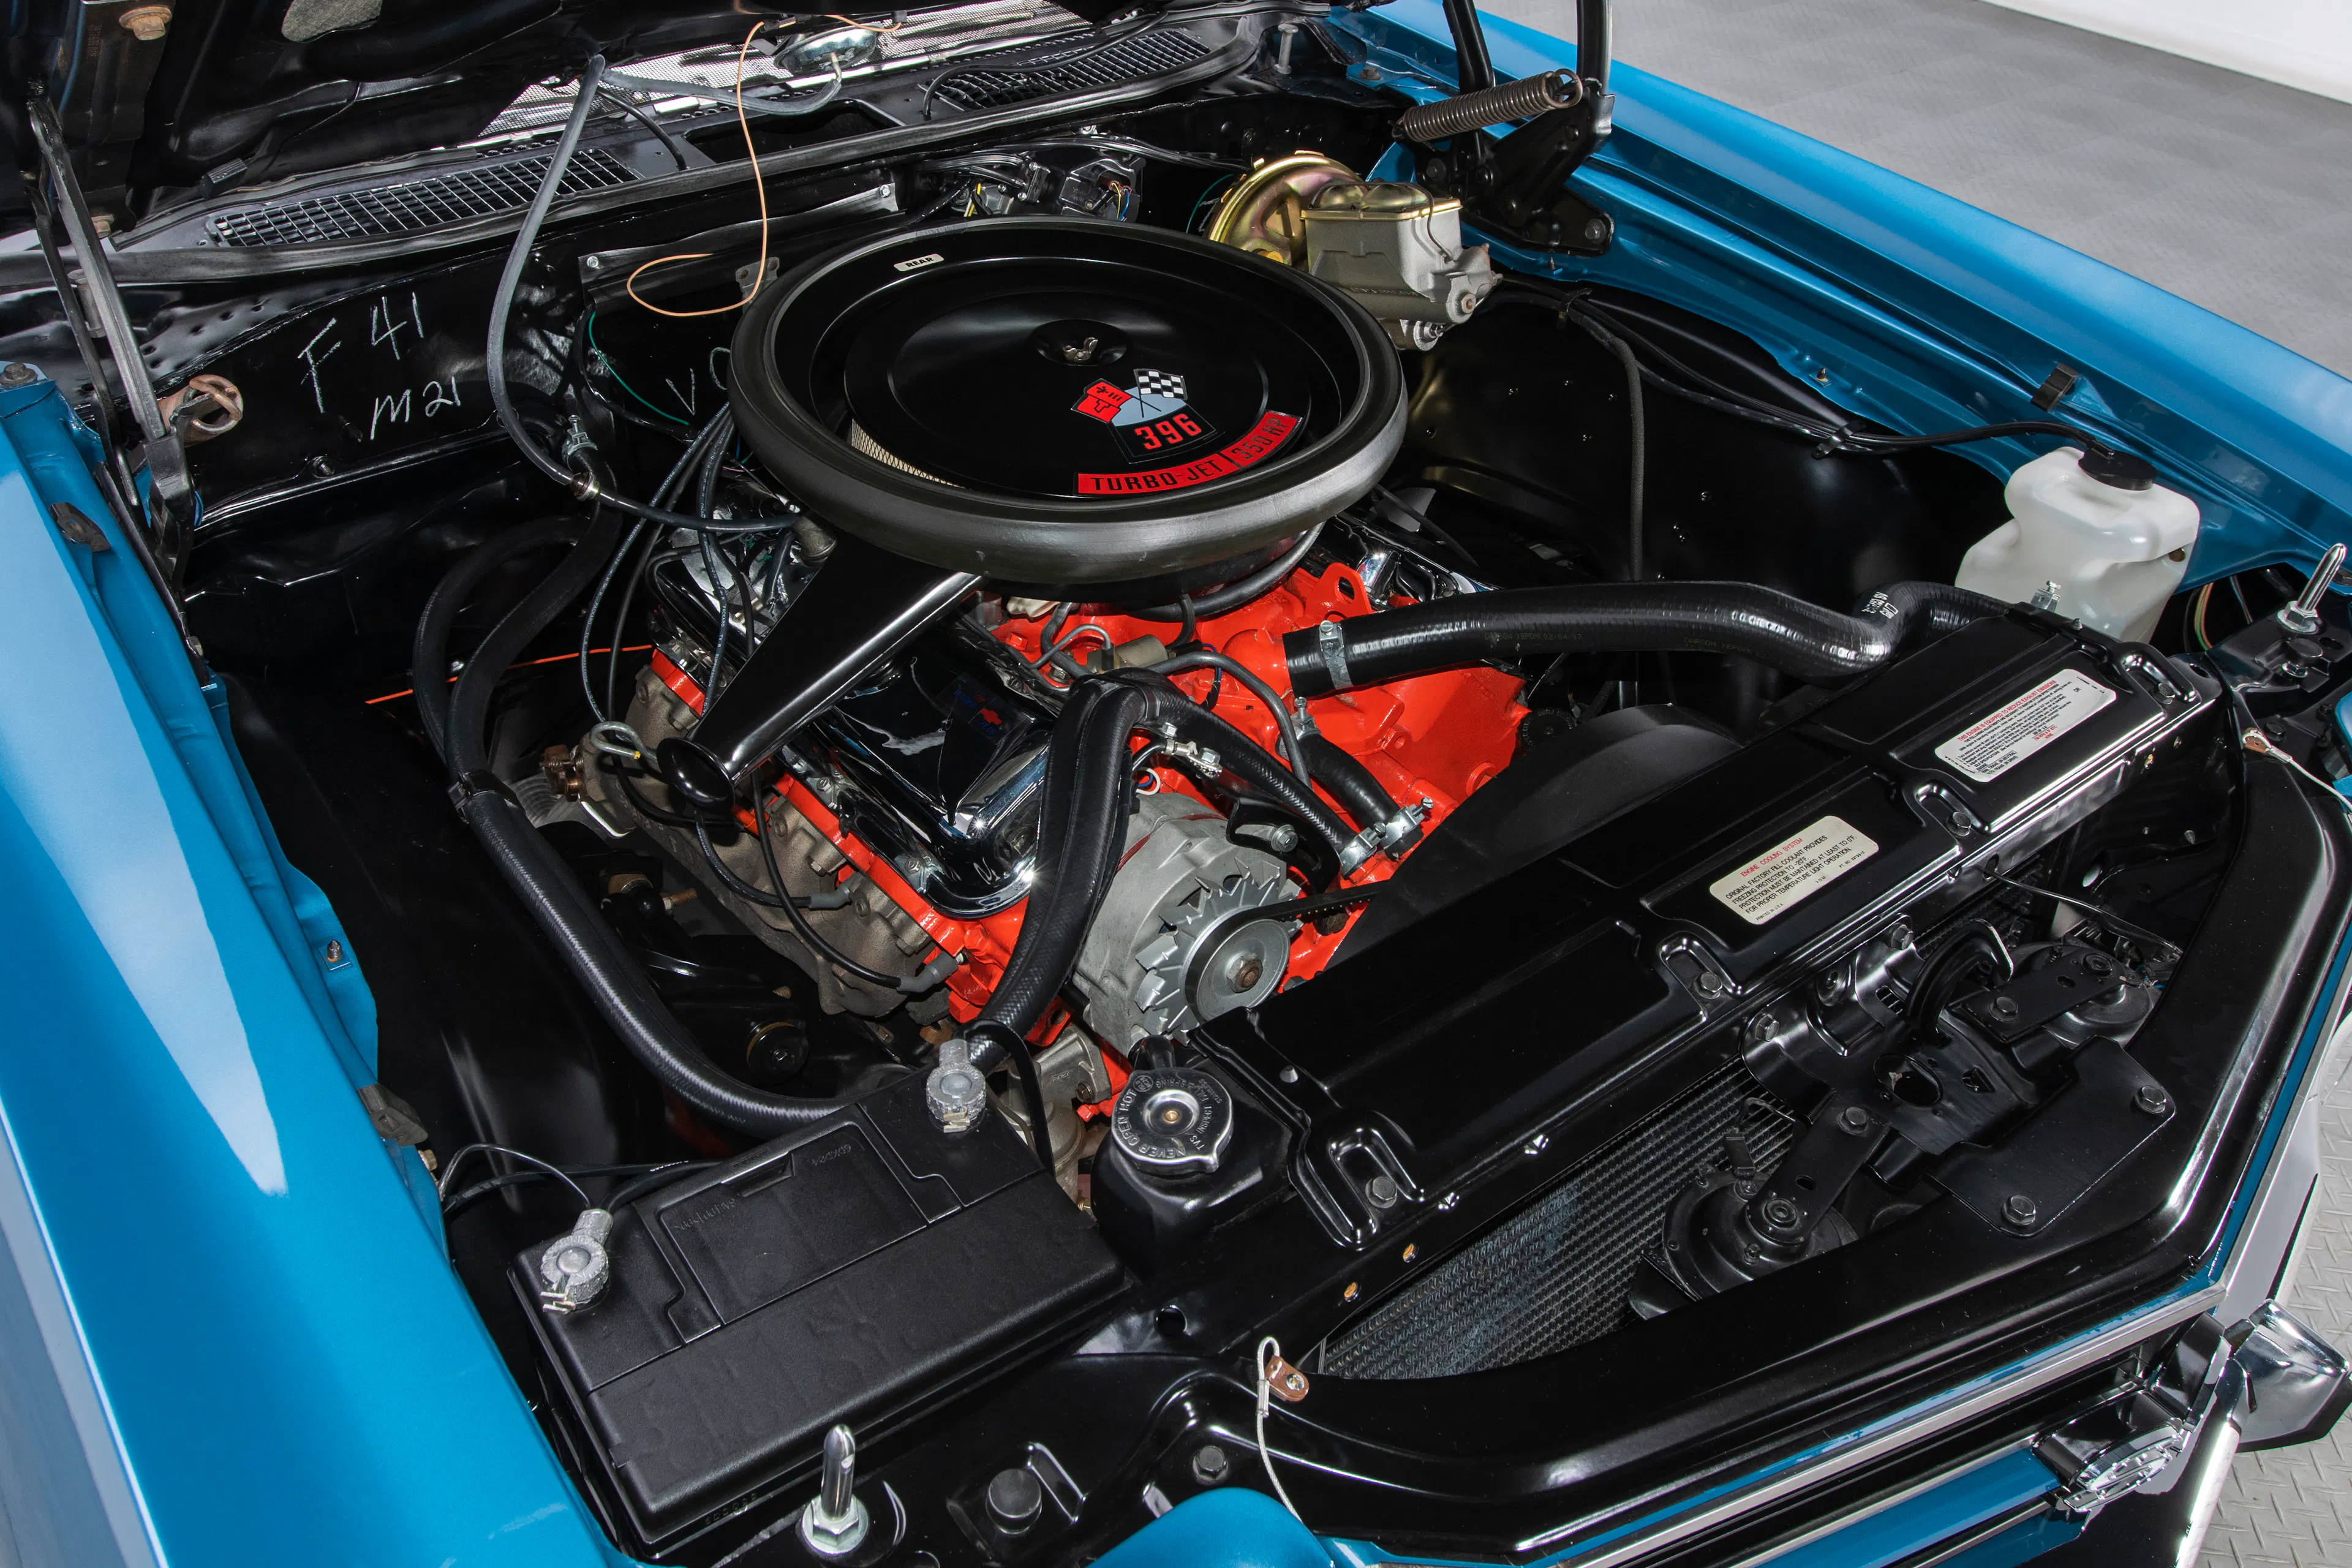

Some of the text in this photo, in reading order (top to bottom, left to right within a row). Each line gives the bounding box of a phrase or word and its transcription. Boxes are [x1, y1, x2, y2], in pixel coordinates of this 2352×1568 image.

[905, 257, 934, 267] REAR
[1135, 413, 1202, 450] 396
[1091, 417, 1289, 491] TURBO-JET 350 HP
[1966, 726, 1982, 736] ENGINE
[1983, 712, 2003, 725] EQUIPPED
[2006, 700, 2023, 710] REDUCE
[2020, 691, 2038, 702] EXHAUST
[2035, 679, 2056, 692] EMISSIONS
[1724, 835, 1828, 899] ORIGINAL FACTORY FILL COOLANT PROVIDES
[1740, 837, 1804, 876] ENGINE COOLING SYSTEM
[1731, 888, 1758, 904] FREEZING
[1754, 869, 1788, 890] PROTECTION
[1738, 888, 1771, 909] PROTECTION
[1768, 879, 1785, 890] MUST
[1789, 858, 1820, 877] MAINTAINED
[1823, 844, 1841, 856] LEAST
[1744, 905, 1758, 914] FOR
[1755, 892, 1779, 907] PROPER
[1775, 872, 1812, 895] TEMPERATURE
[1809, 863, 1825, 874] LIGHT
[1755, 910, 1771, 921] PRINTED
[1156, 1079, 1187, 1088] SPRING
[1199, 1079, 1223, 1103] STAINLESS
[1117, 1089, 1186, 1159] NEVER OPEN HOT
[1195, 1106, 1213, 1134] INSPECT
[1189, 1134, 1205, 1150] TVS
